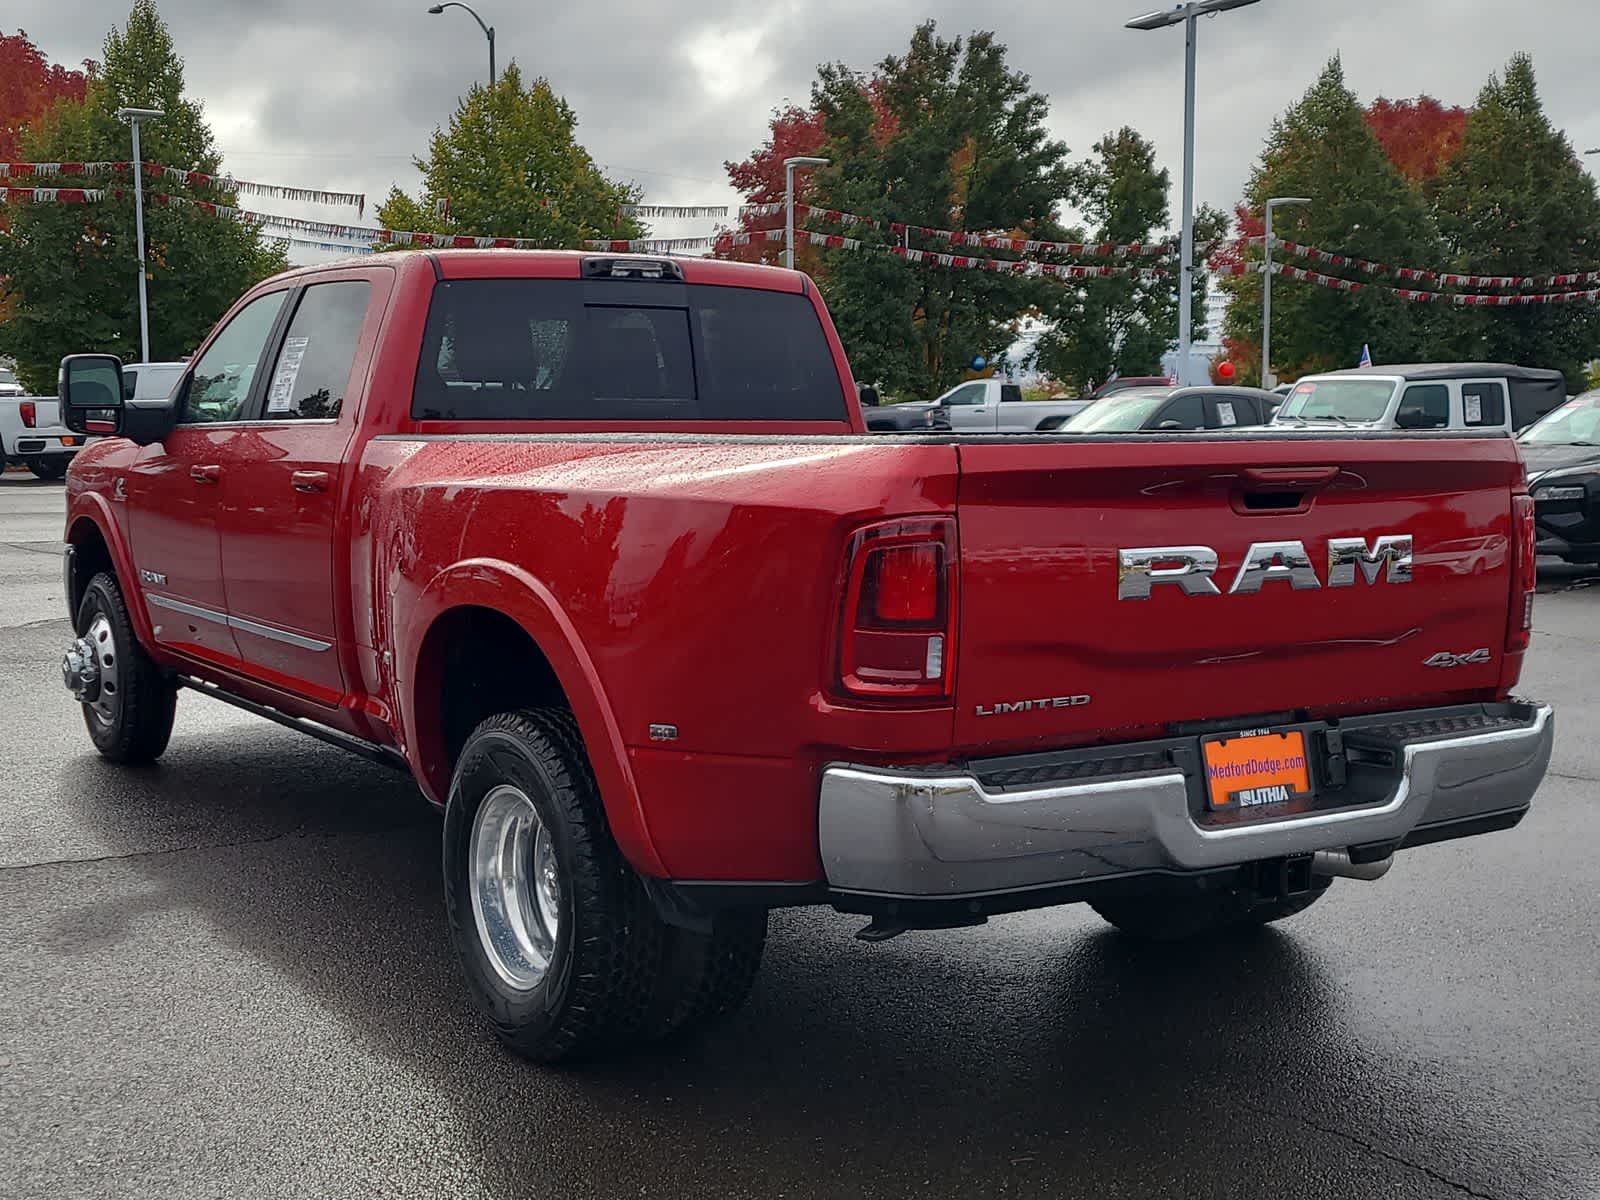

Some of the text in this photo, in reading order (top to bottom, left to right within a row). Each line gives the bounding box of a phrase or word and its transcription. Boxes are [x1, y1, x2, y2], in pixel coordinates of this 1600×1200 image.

[1118, 534, 1413, 600] RAM
[1423, 647, 1491, 667] 4x4
[976, 695, 1090, 715] LIMITED
[1239, 729, 1256, 738] SINCE
[1208, 756, 1304, 779] MedfordDodge.com
[1251, 785, 1289, 805] LITHIA
